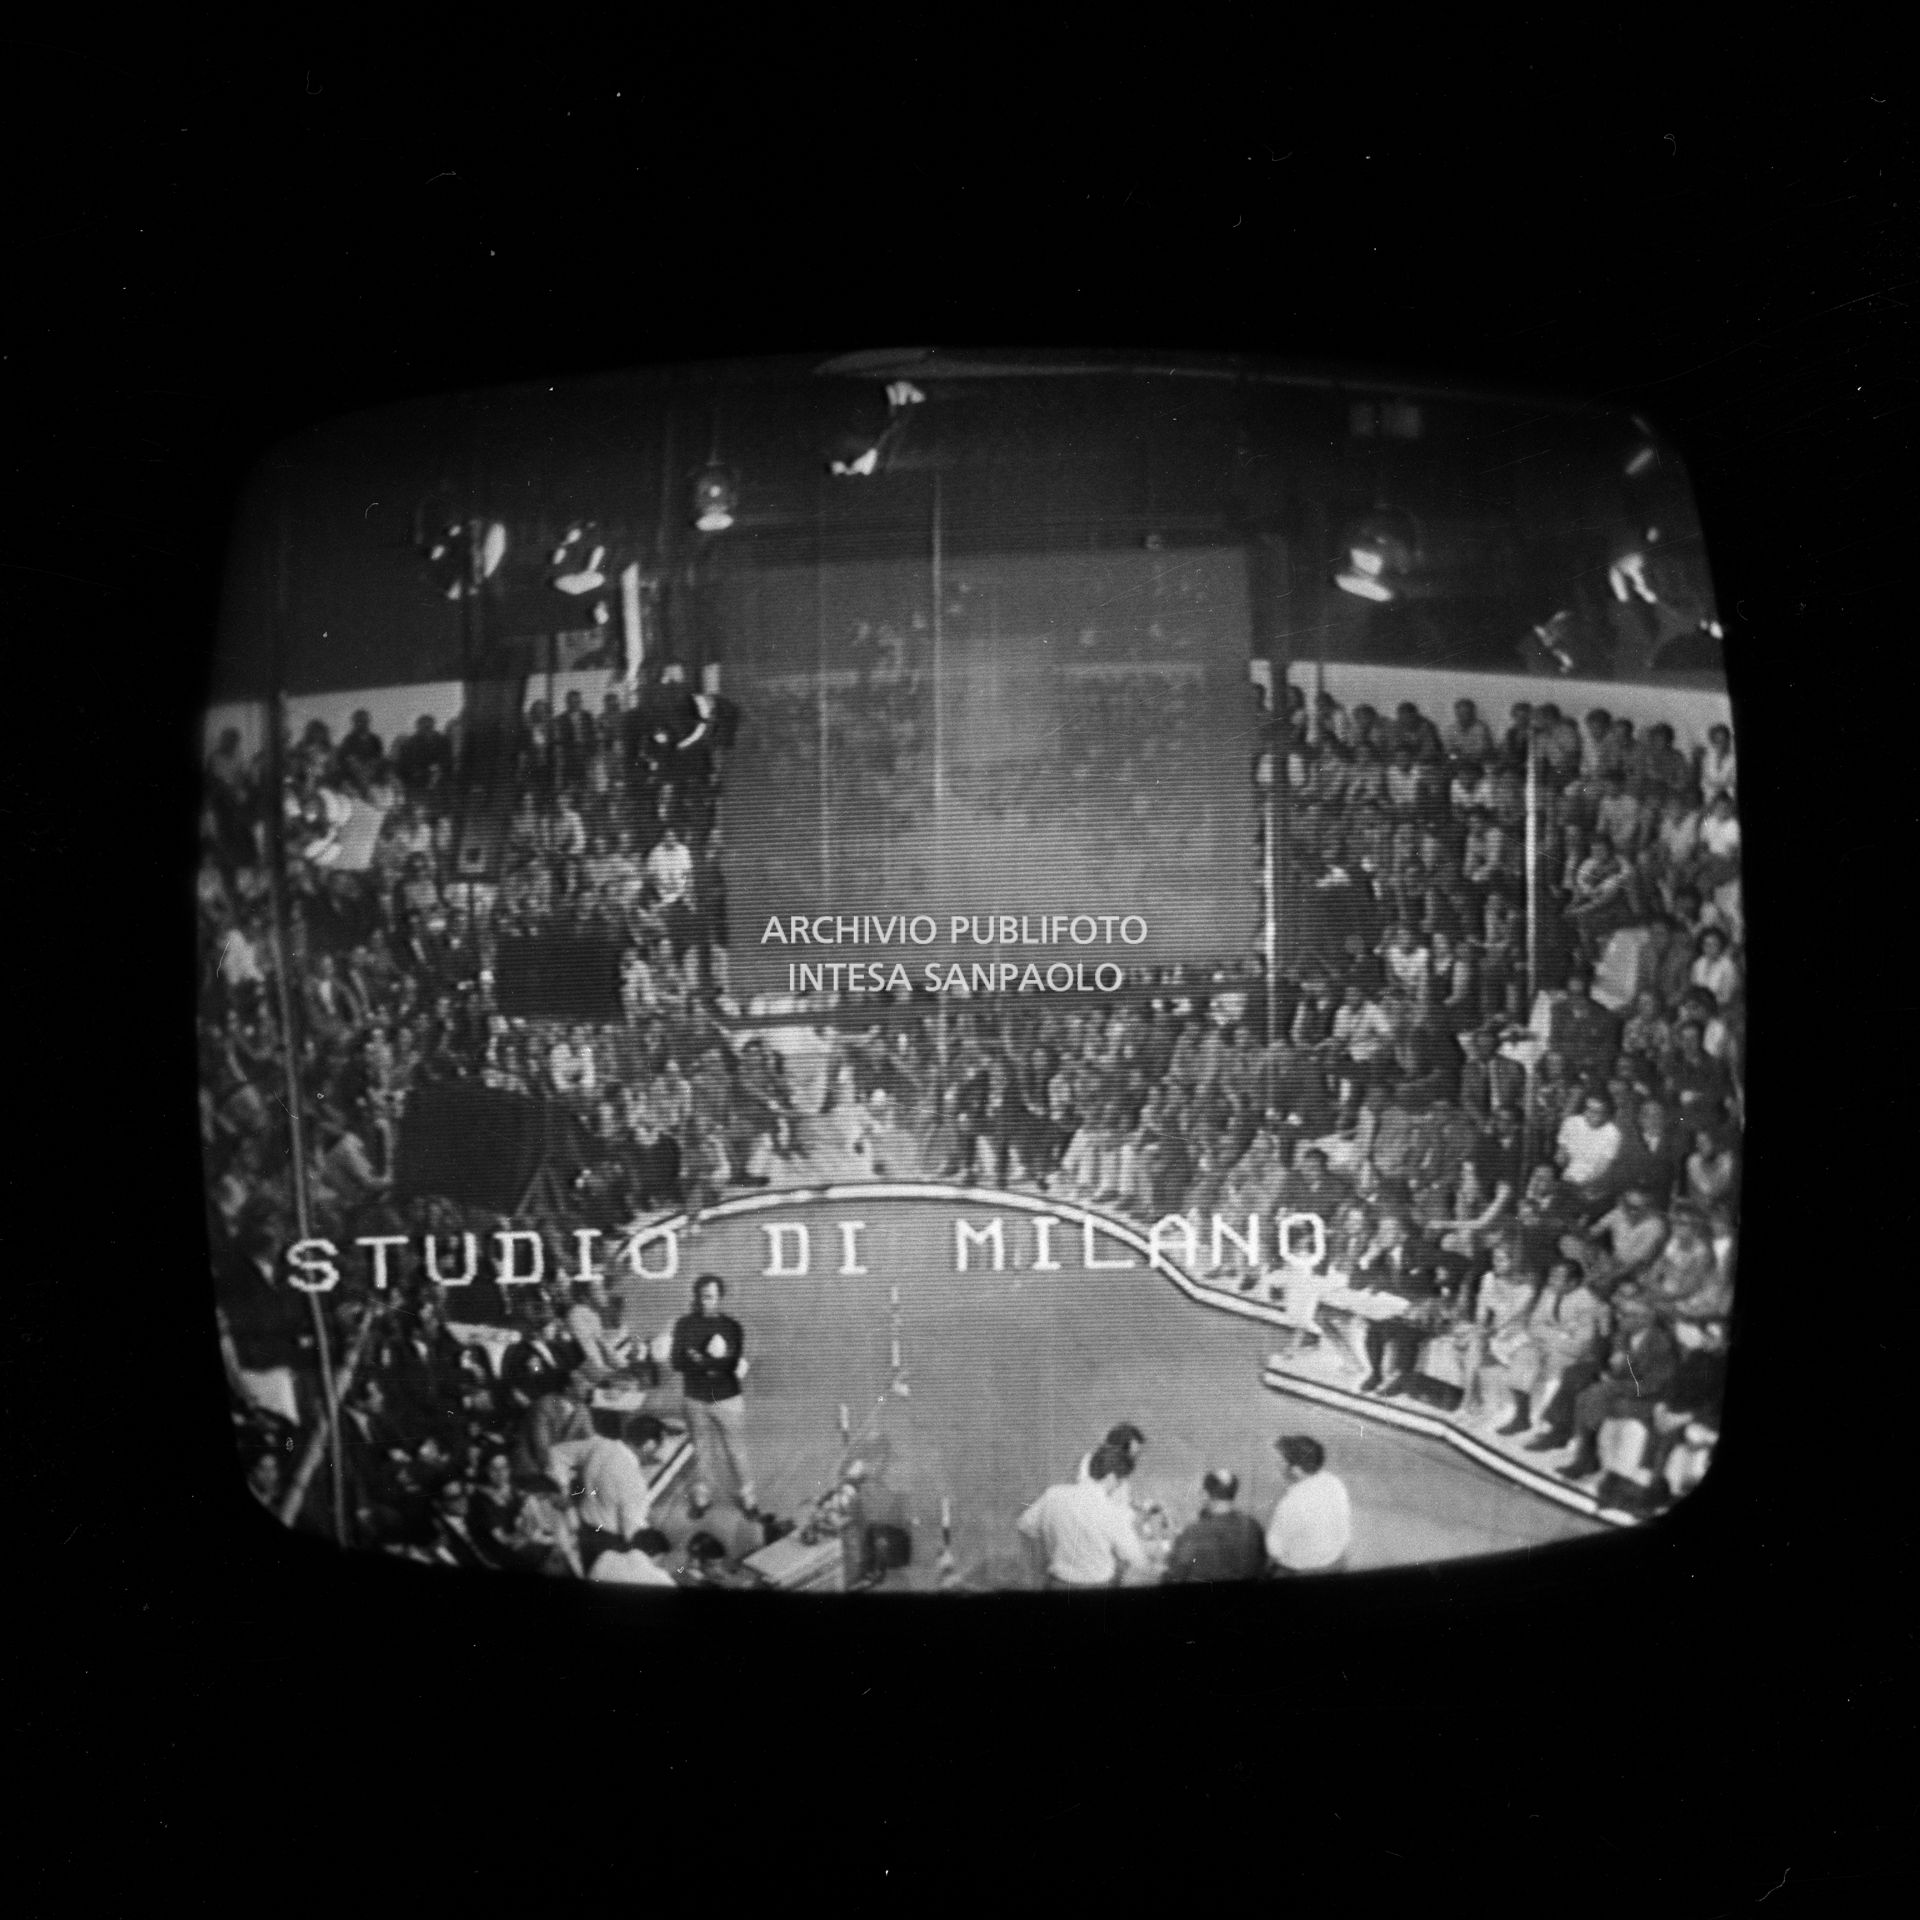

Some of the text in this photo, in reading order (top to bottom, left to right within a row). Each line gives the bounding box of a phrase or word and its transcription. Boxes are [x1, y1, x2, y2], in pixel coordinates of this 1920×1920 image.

[286, 1213, 1326, 1292] STUDIO DI MILANO
